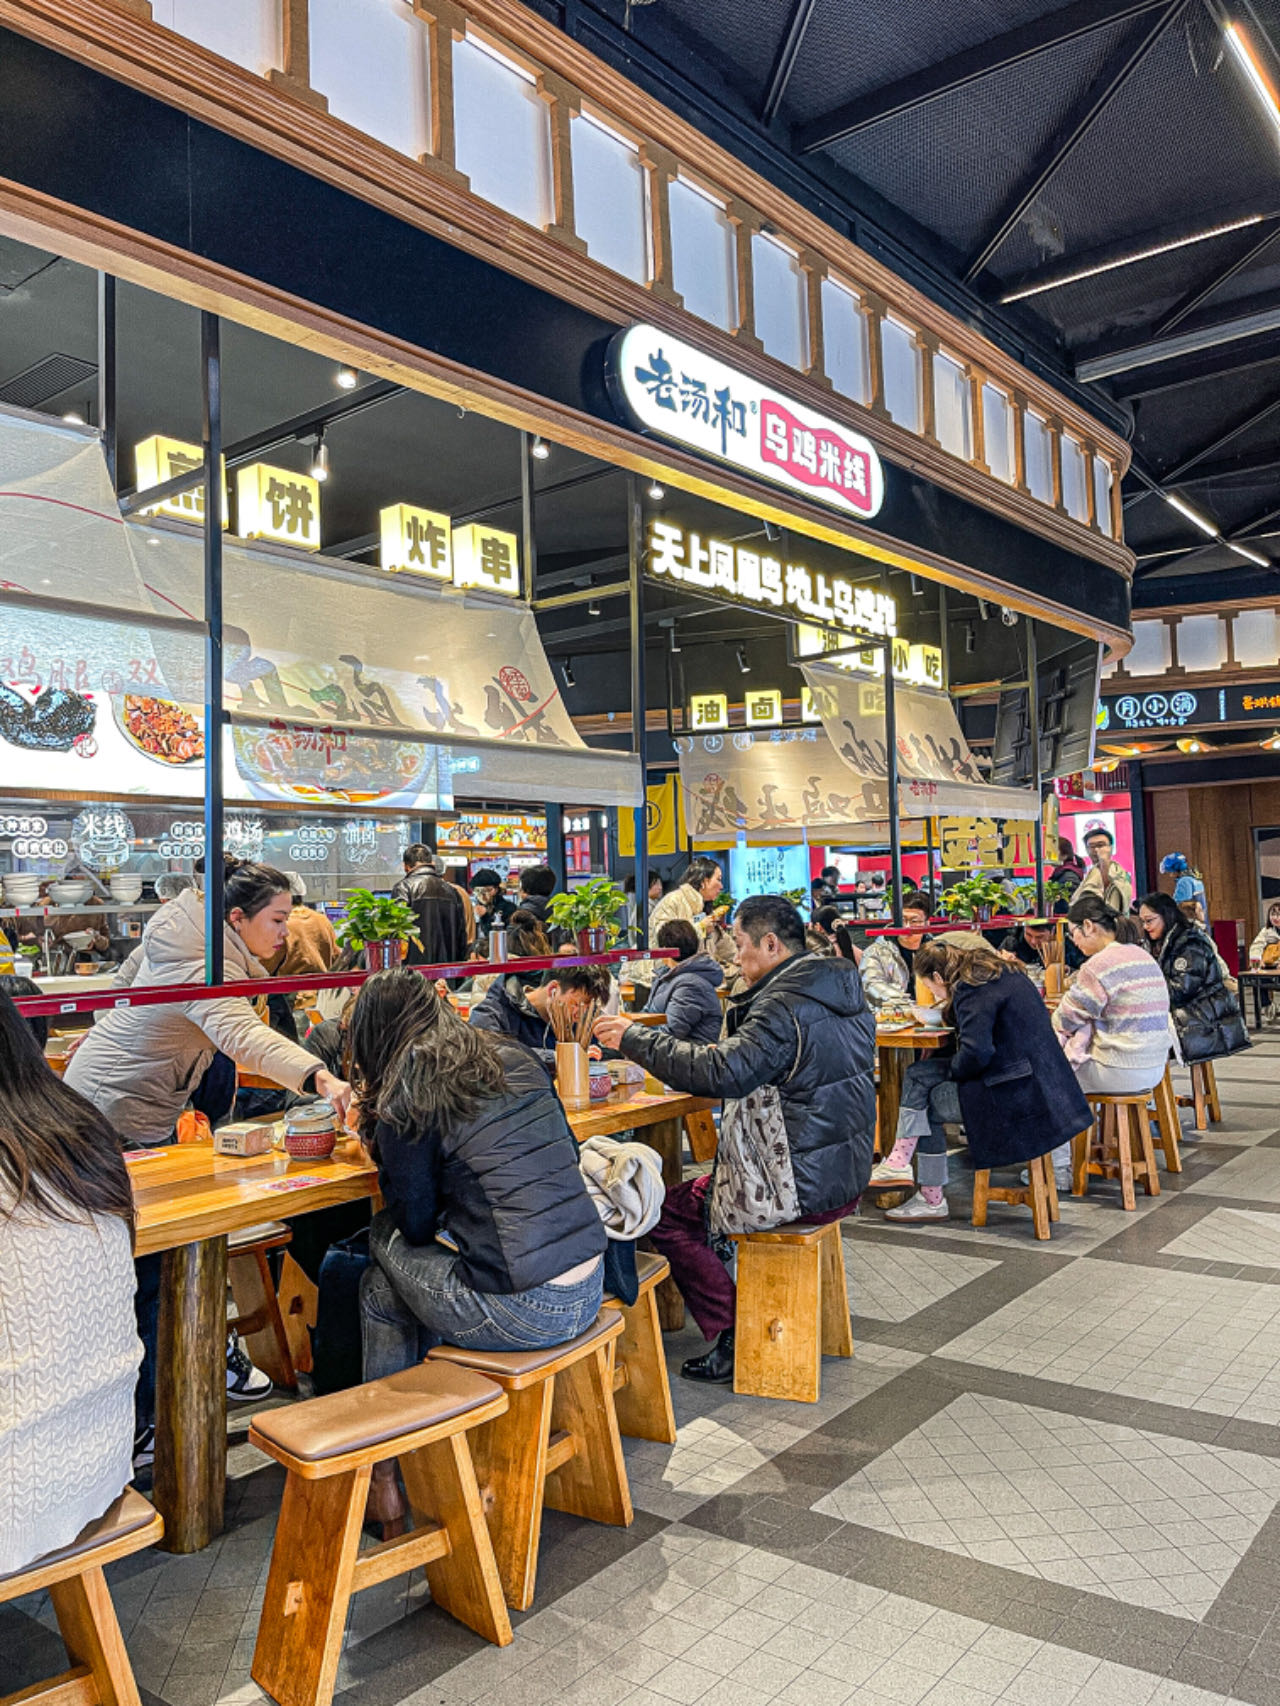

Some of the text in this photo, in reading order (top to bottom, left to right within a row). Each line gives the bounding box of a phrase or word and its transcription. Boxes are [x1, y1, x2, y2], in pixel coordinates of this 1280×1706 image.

[634, 348, 868, 498] 老汤和 乌鸡米线
[406, 515, 512, 584] 炸串
[80, 813, 127, 839] 米线
